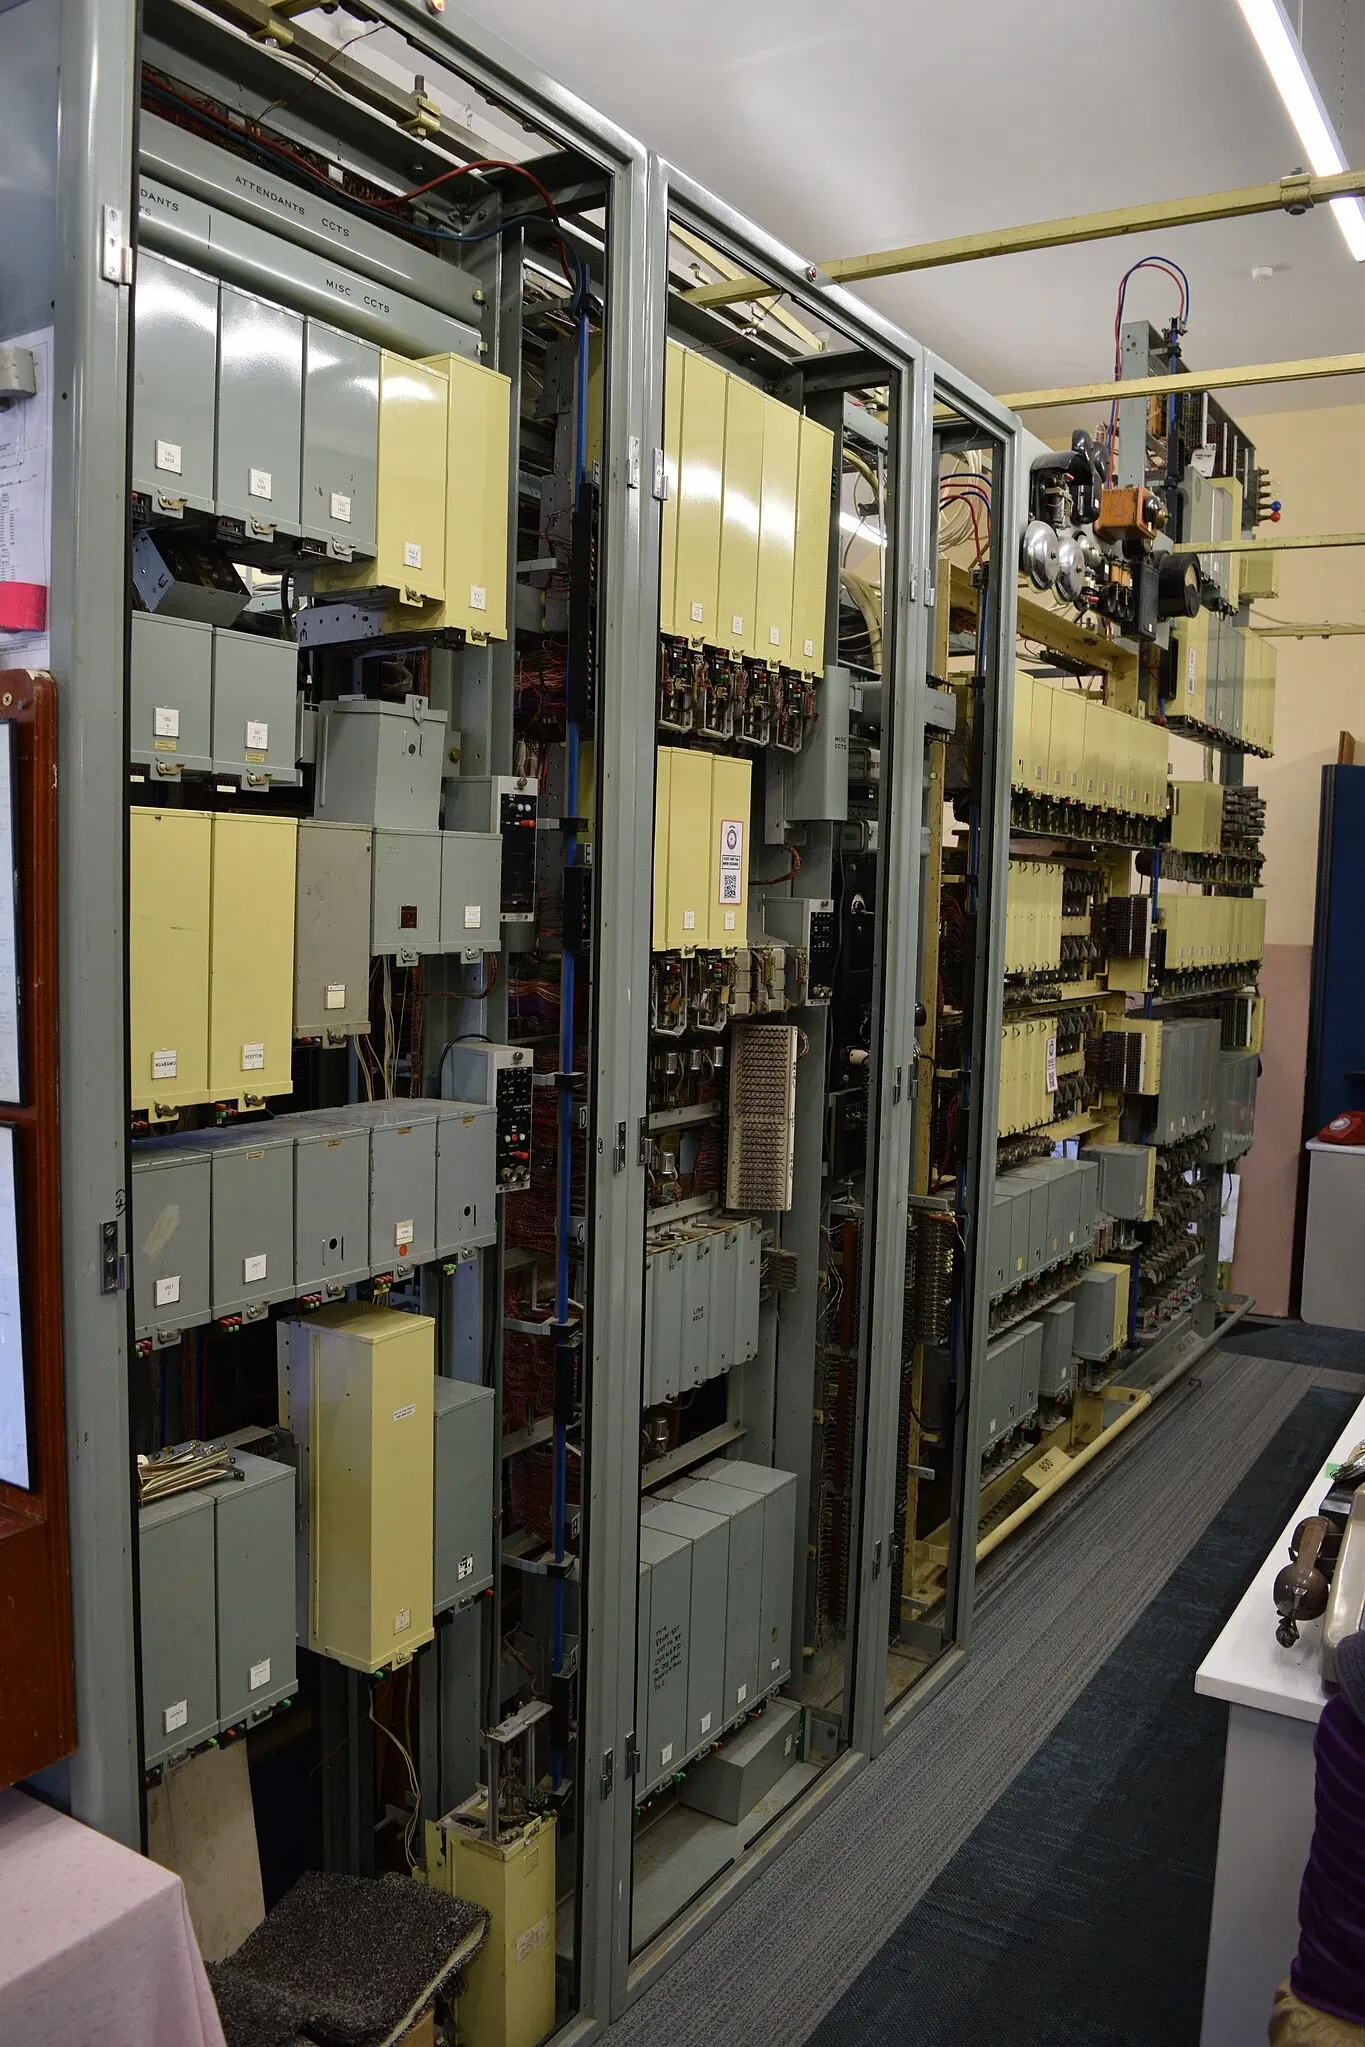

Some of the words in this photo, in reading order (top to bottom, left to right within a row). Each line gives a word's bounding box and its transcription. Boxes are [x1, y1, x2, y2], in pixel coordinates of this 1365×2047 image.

[140, 188, 179, 212] DANTS
[235, 175, 306, 215] ATTENDANTS
[321, 217, 350, 237] CCTS
[325, 279, 351, 296] MISC
[363, 295, 390, 313] CCTS
[585, 843, 591, 864] E
[581, 1108, 587, 1127] D
[578, 1224, 584, 1243] C
[692, 1312, 704, 1322] RELS
[693, 1305, 704, 1315] LINE
[1038, 1458, 1053, 1472] 800
